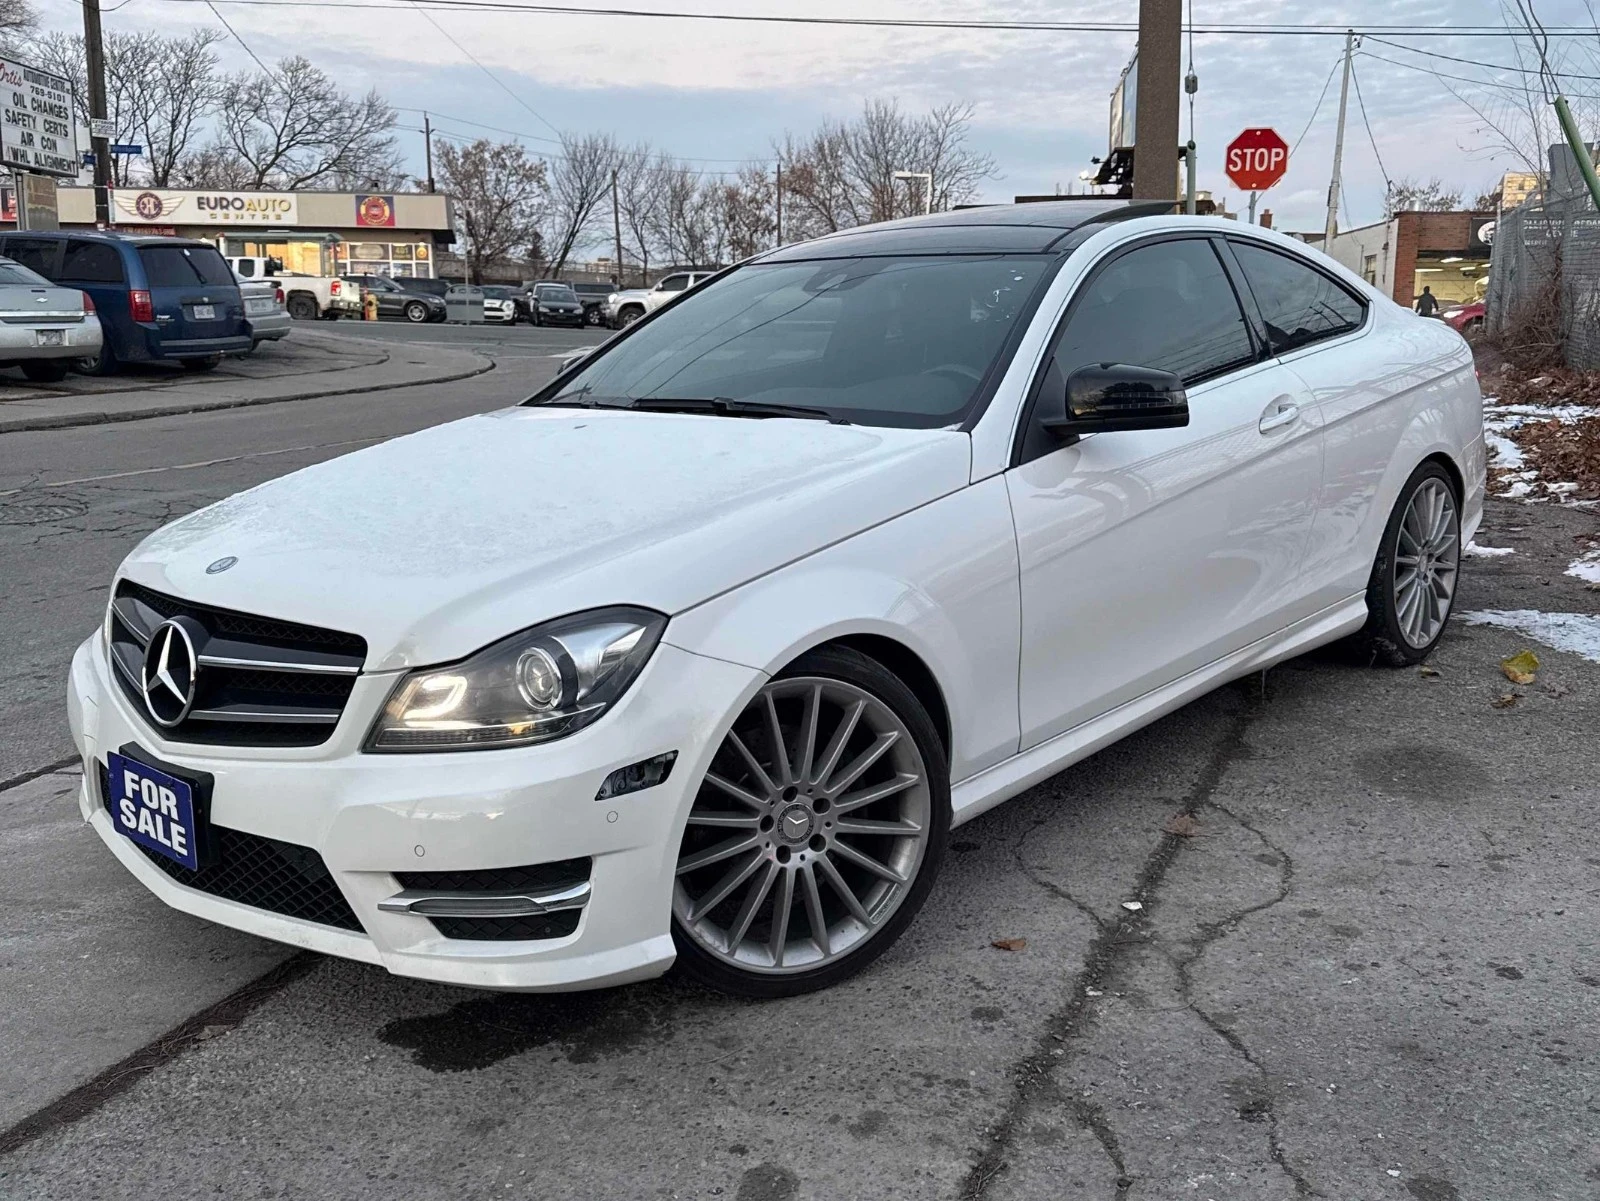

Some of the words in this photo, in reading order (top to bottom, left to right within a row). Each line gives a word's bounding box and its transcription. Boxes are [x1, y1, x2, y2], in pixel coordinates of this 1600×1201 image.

[13, 92, 27, 109] OIL
[31, 97, 69, 120] CHANGES
[5, 108, 36, 130] SAFETY
[43, 118, 69, 138] CERTS
[20, 130, 35, 147] AIR
[41, 136, 58, 153] CON
[34, 152, 76, 174] ALIGNMENT
[1228, 147, 1285, 172] STOP
[209, 212, 283, 222] CENTRE
[123, 769, 179, 821] FOR
[119, 798, 188, 857] SALE
